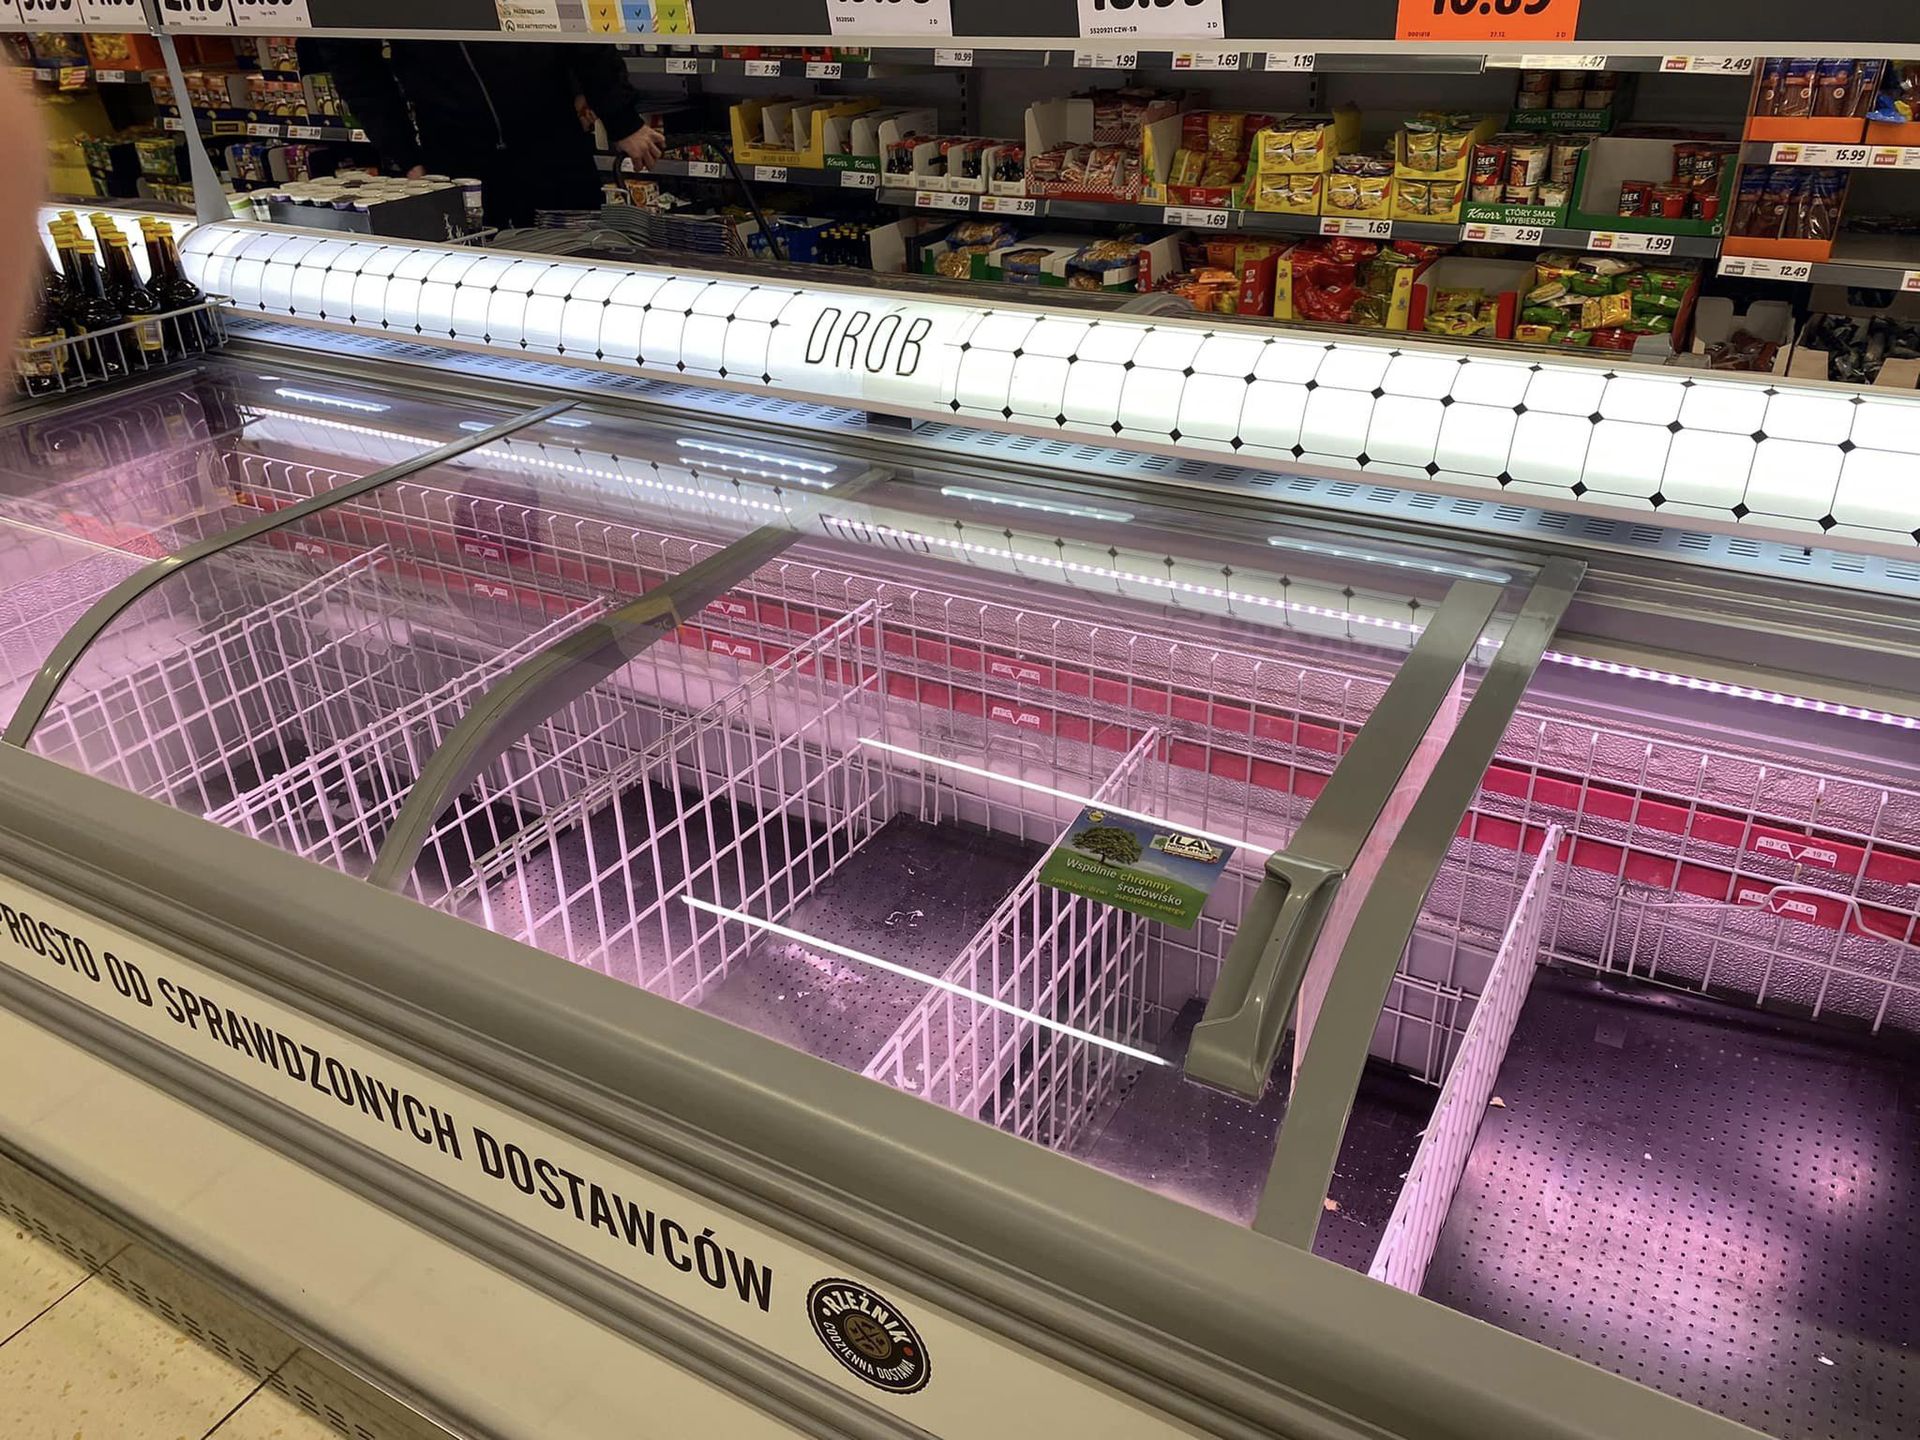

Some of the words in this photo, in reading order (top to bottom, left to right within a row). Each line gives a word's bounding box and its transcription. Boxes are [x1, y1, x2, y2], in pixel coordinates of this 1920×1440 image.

[953, 52, 972, 62] 10.99
[1115, 54, 1136, 67] 1.99
[1216, 53, 1238, 67] 1.69
[1292, 55, 1314, 67] 1.19
[681, 60, 697, 71] 1.49
[764, 64, 780, 75] 2.99
[824, 65, 840, 76] 2.99
[1721, 58, 1752, 71] 2.49
[1835, 149, 1866, 161] 15.99
[771, 170, 786, 180] 2.99
[858, 175, 875, 186] 2.19
[951, 195, 969, 207] 4.99
[1016, 200, 1035, 212] 3.99
[1206, 213, 1226, 226] 1.69
[1467, 207, 1502, 220] Knorr
[1504, 208, 1532, 217] KTÓRY
[1532, 209, 1557, 218] SMAK
[1368, 221, 1390, 234] 1.69
[1505, 217, 1556, 226] WYBIERASZ?
[1515, 229, 1541, 241] 2.99
[1645, 236, 1672, 251] 1.99
[1779, 265, 1808, 277] 12.49
[805, 306, 933, 377] DRÓB
[1119, 873, 1172, 893] chronmy
[1116, 882, 1182, 906] środowisko
[0, 902, 100, 982] ROSTO
[103, 951, 153, 1007] OD
[157, 976, 462, 1161] SPRAWDZONYCH
[472, 1126, 773, 1313] DOSTAWCÓW
[823, 1321, 874, 1376] CODZIENNA
[876, 1358, 916, 1380] DOSTAWA
